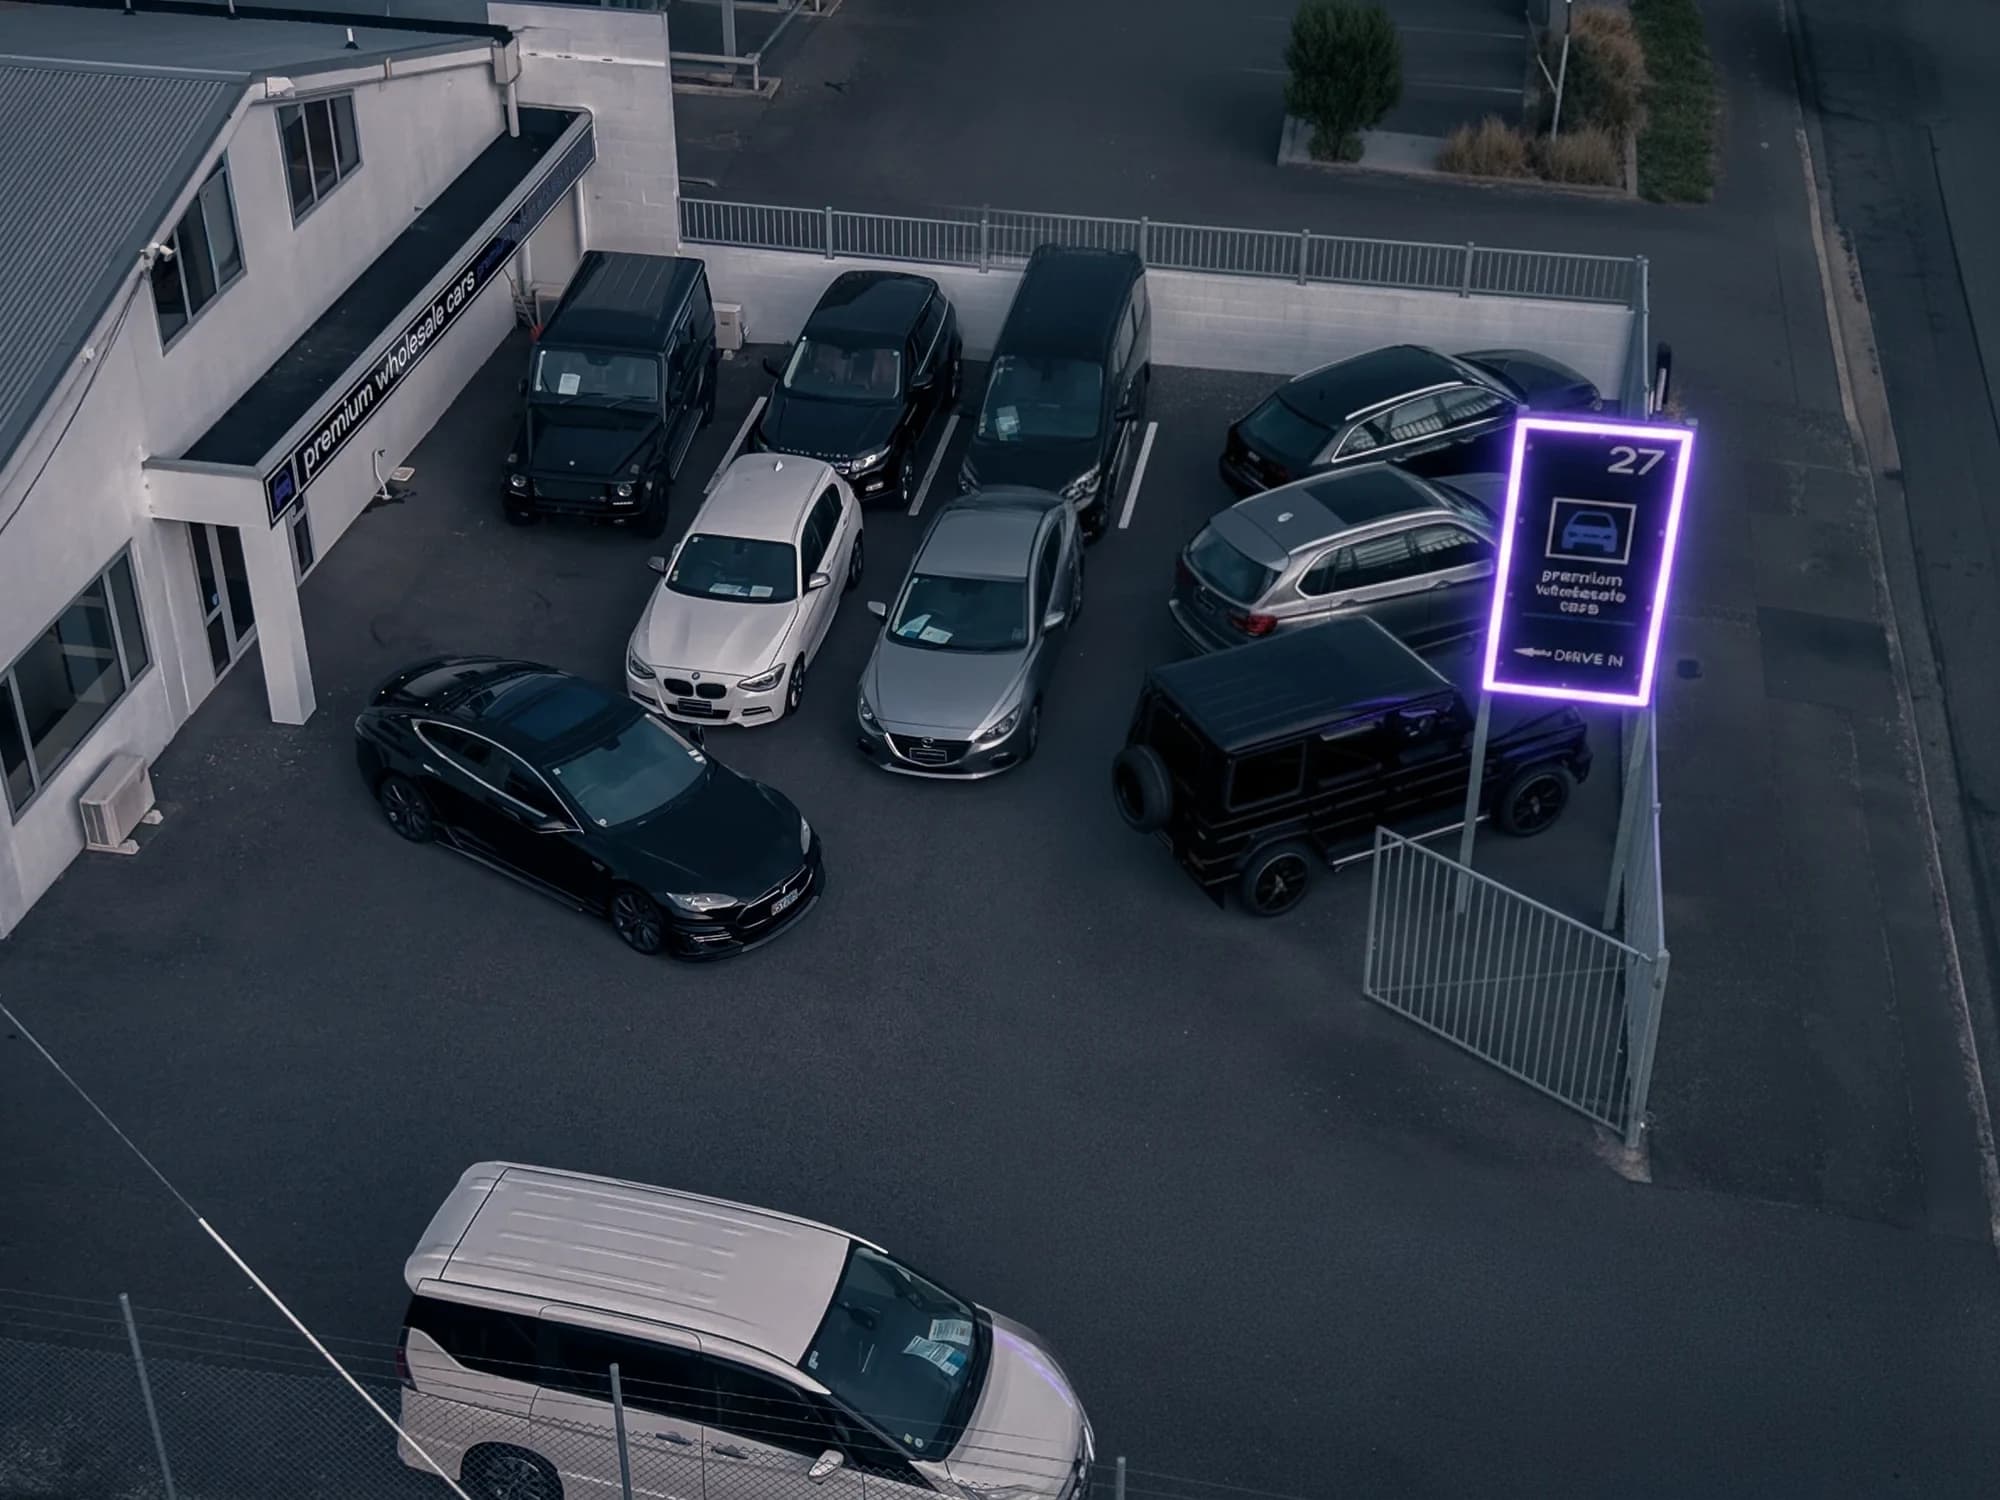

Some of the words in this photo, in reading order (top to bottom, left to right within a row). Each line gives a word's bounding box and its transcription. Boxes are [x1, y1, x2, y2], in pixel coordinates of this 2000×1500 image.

[303, 385, 374, 478] premium
[375, 302, 444, 391] wholesale
[447, 271, 475, 313] cars
[1607, 446, 1665, 475] 27
